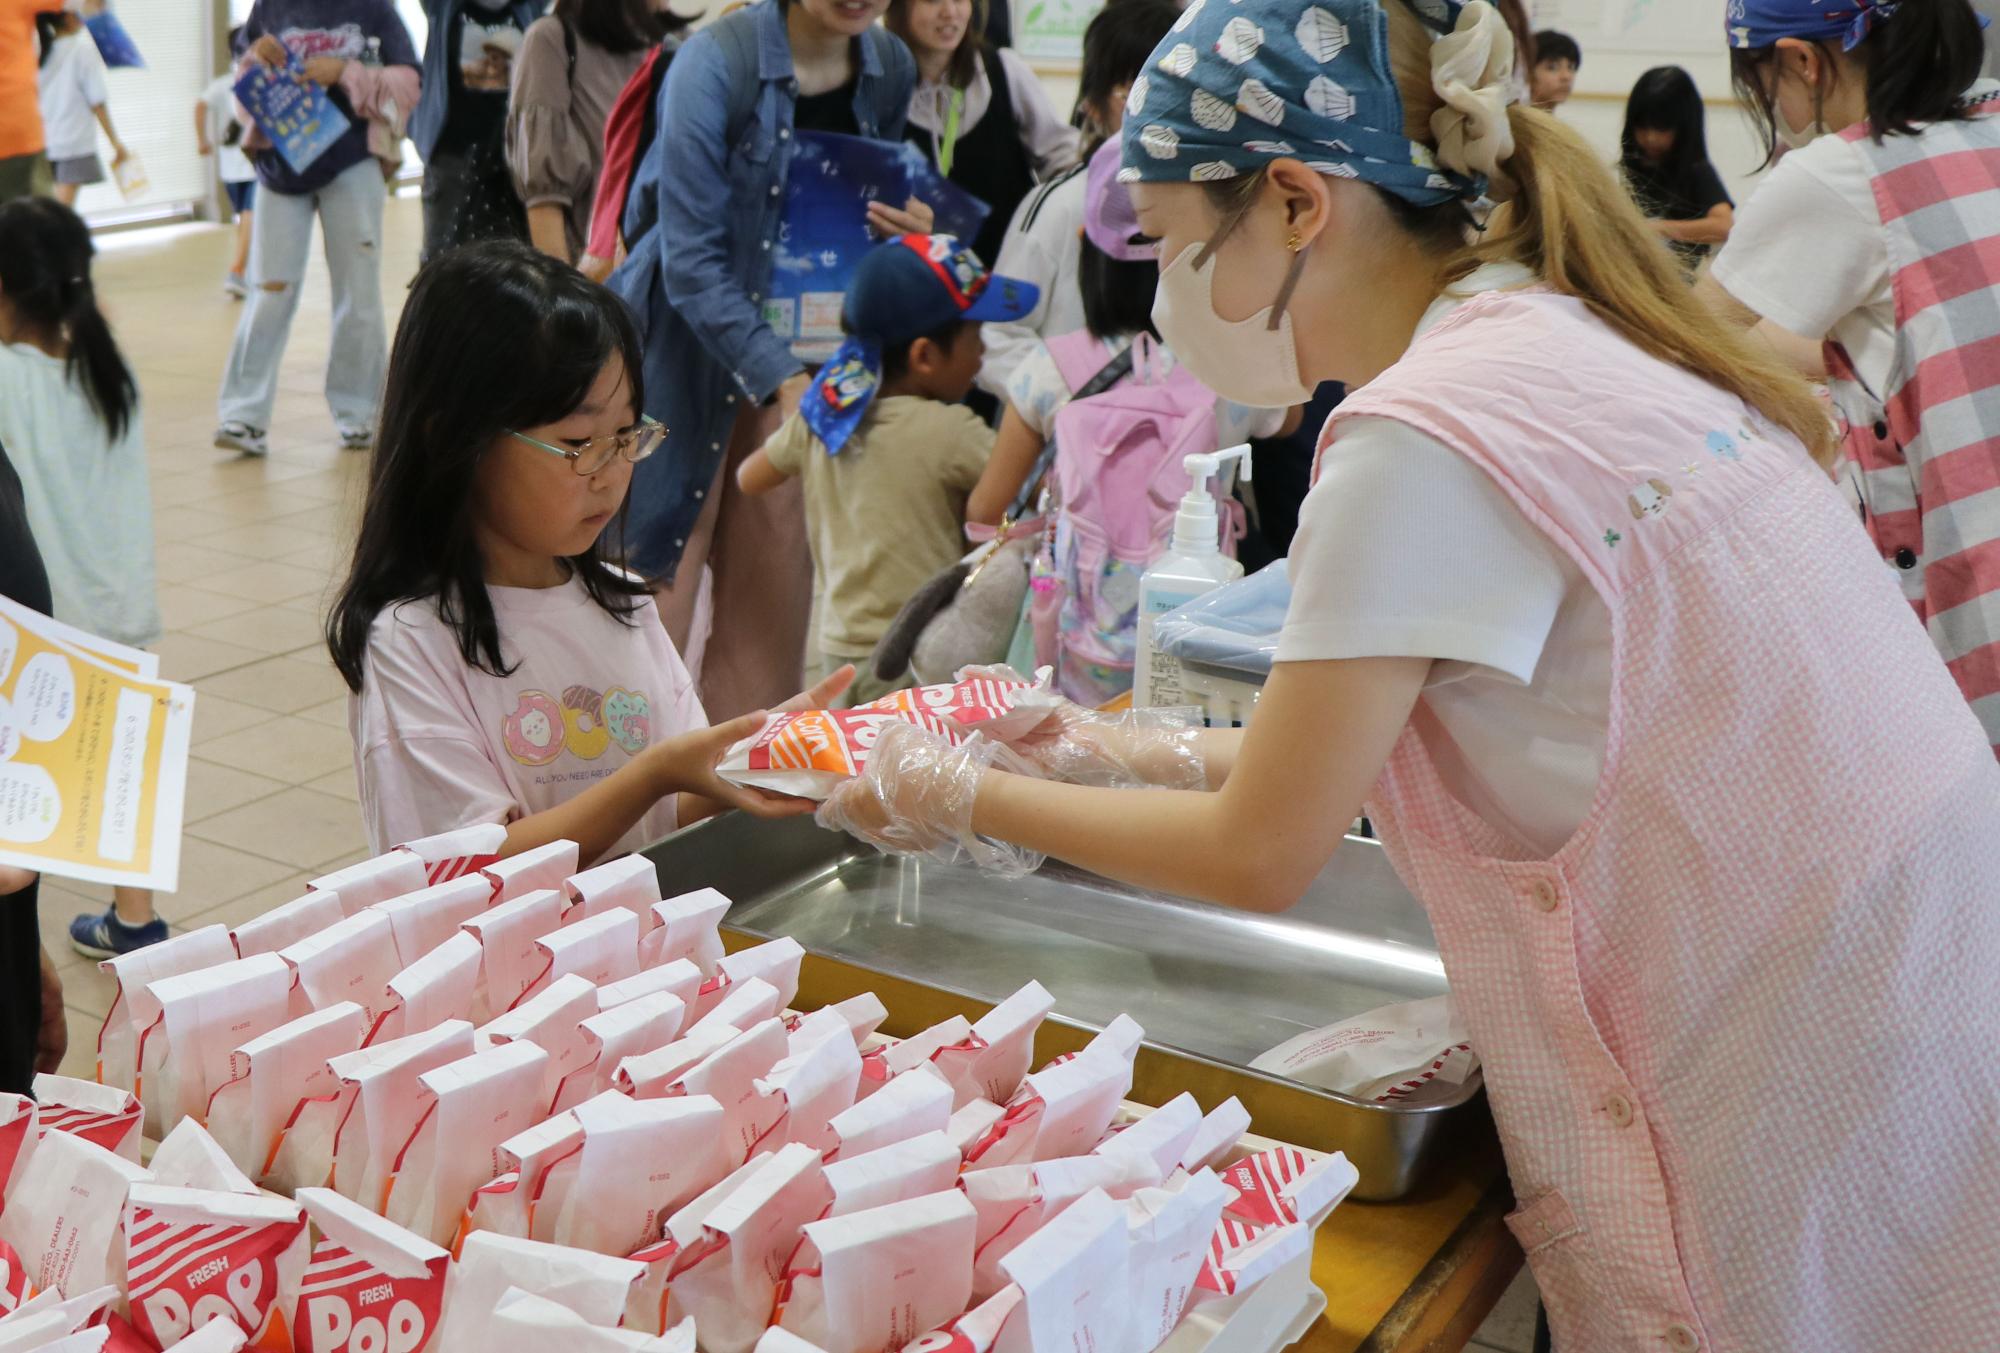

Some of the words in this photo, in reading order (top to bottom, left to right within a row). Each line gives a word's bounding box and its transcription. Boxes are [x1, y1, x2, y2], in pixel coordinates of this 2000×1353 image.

[1235, 1167, 1257, 1191] FRESH
[51, 1216, 64, 1248] DEALERS
[186, 1255, 230, 1290] FRESH
[359, 1283, 394, 1307] FRESH
